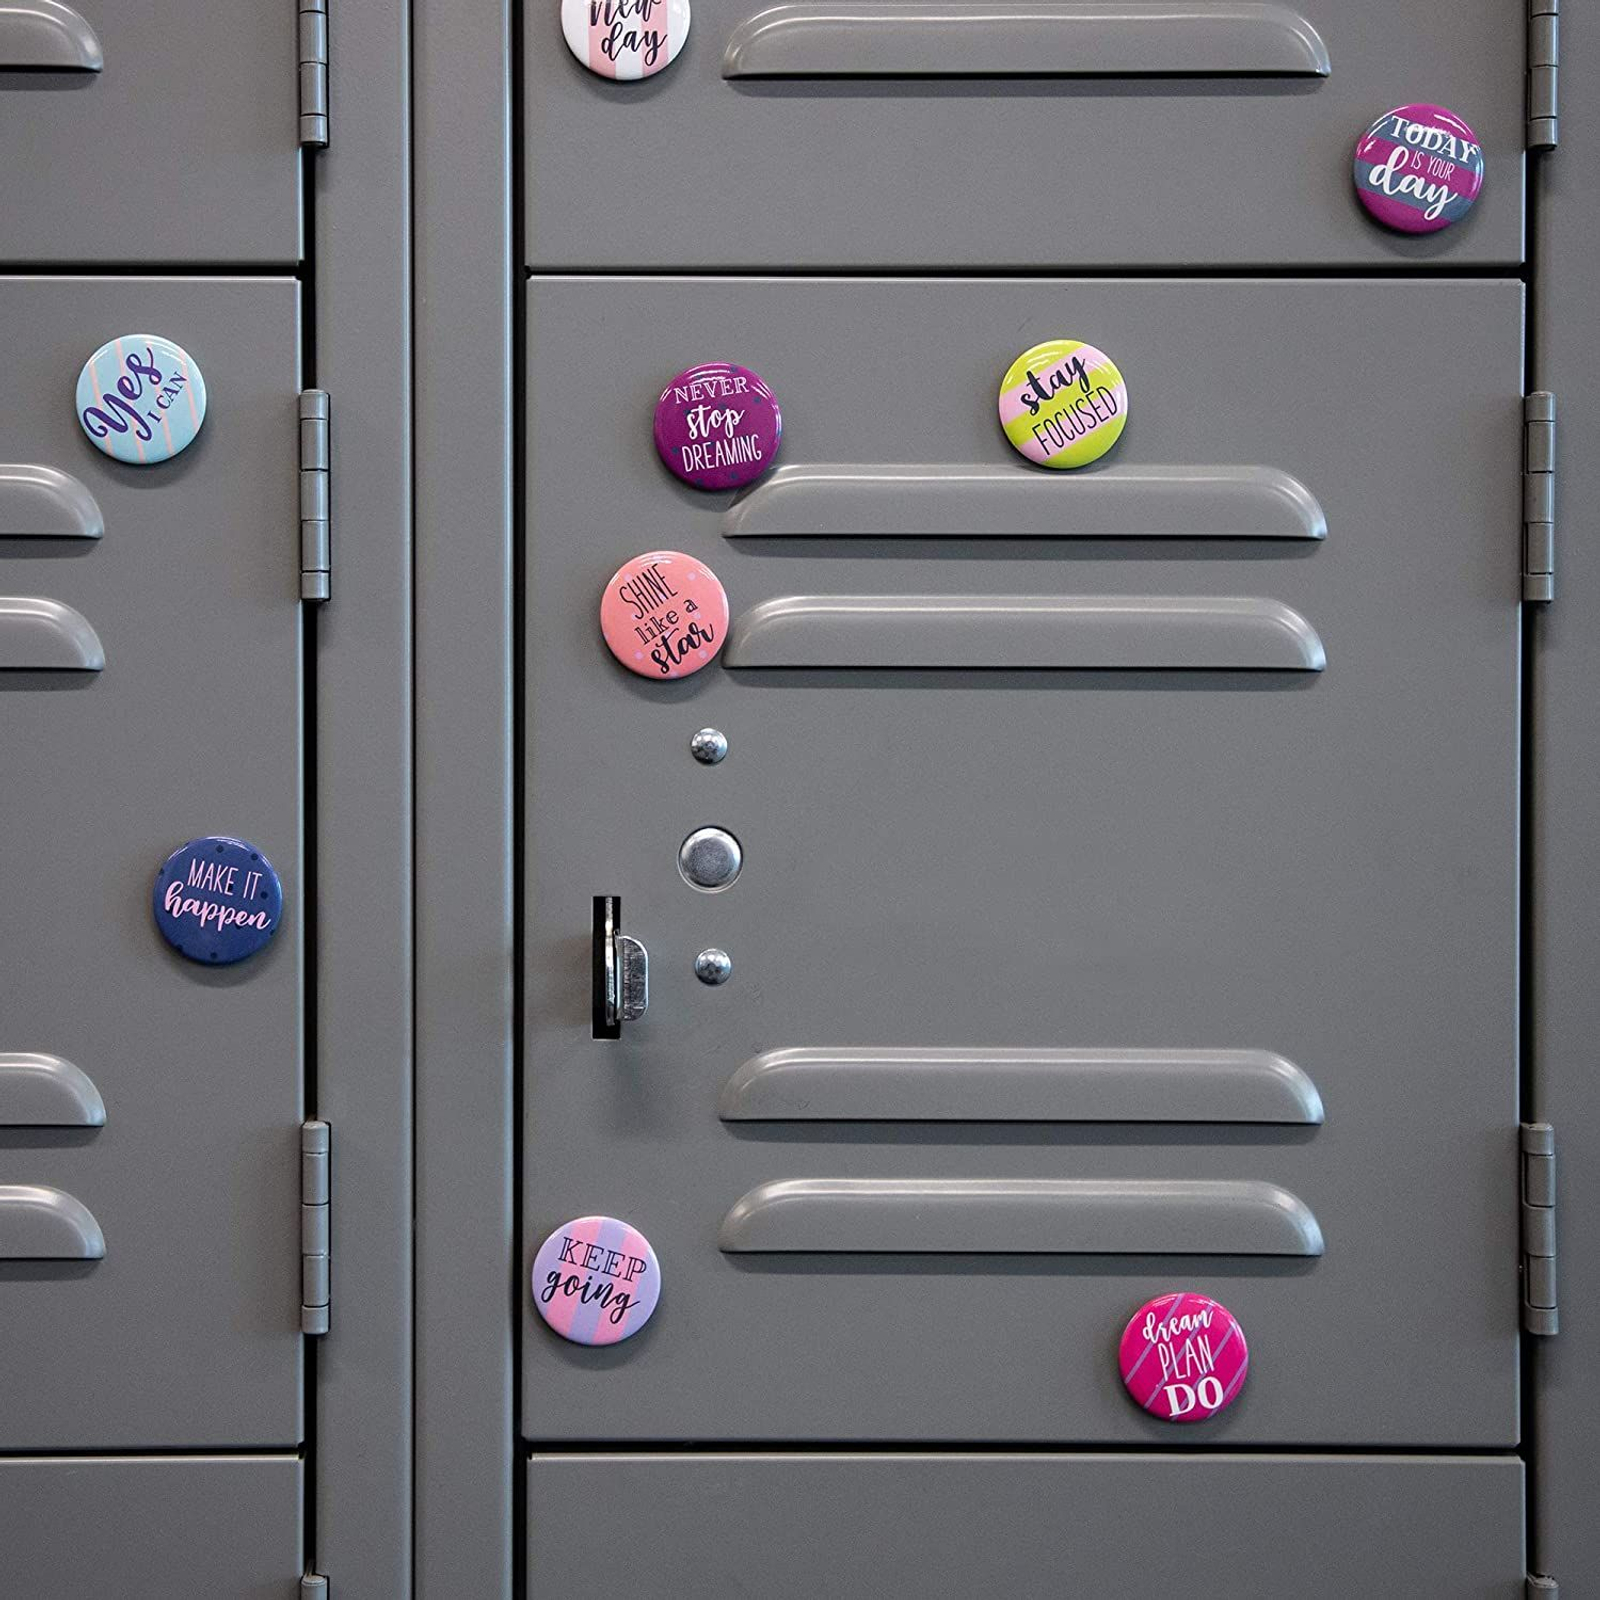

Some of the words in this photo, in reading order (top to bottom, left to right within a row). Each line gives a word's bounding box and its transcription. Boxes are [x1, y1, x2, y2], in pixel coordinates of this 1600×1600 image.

[601, 21, 668, 66] day
[1390, 115, 1480, 163] TODAY
[1369, 146, 1458, 220] day
[1410, 151, 1424, 170] IS
[1427, 156, 1455, 181] YOUR
[147, 410, 162, 424] I
[156, 371, 188, 410] CAN
[674, 376, 750, 404] NEVER
[1020, 356, 1091, 416] stay
[687, 405, 745, 440] stop
[1032, 386, 1117, 456] FOCUSED
[681, 434, 762, 472] DREAMING
[619, 564, 678, 619] SHINE
[634, 610, 679, 645] like
[683, 598, 698, 613] a
[650, 622, 714, 674] star
[188, 858, 239, 896] MAKE
[243, 871, 263, 900] IT
[164, 880, 271, 931] happen
[558, 1236, 647, 1282] KEEP
[541, 1270, 640, 1324] going
[1142, 1310, 1213, 1343] dream
[1158, 1334, 1215, 1381] PLAN
[1163, 1377, 1224, 1417] DO
